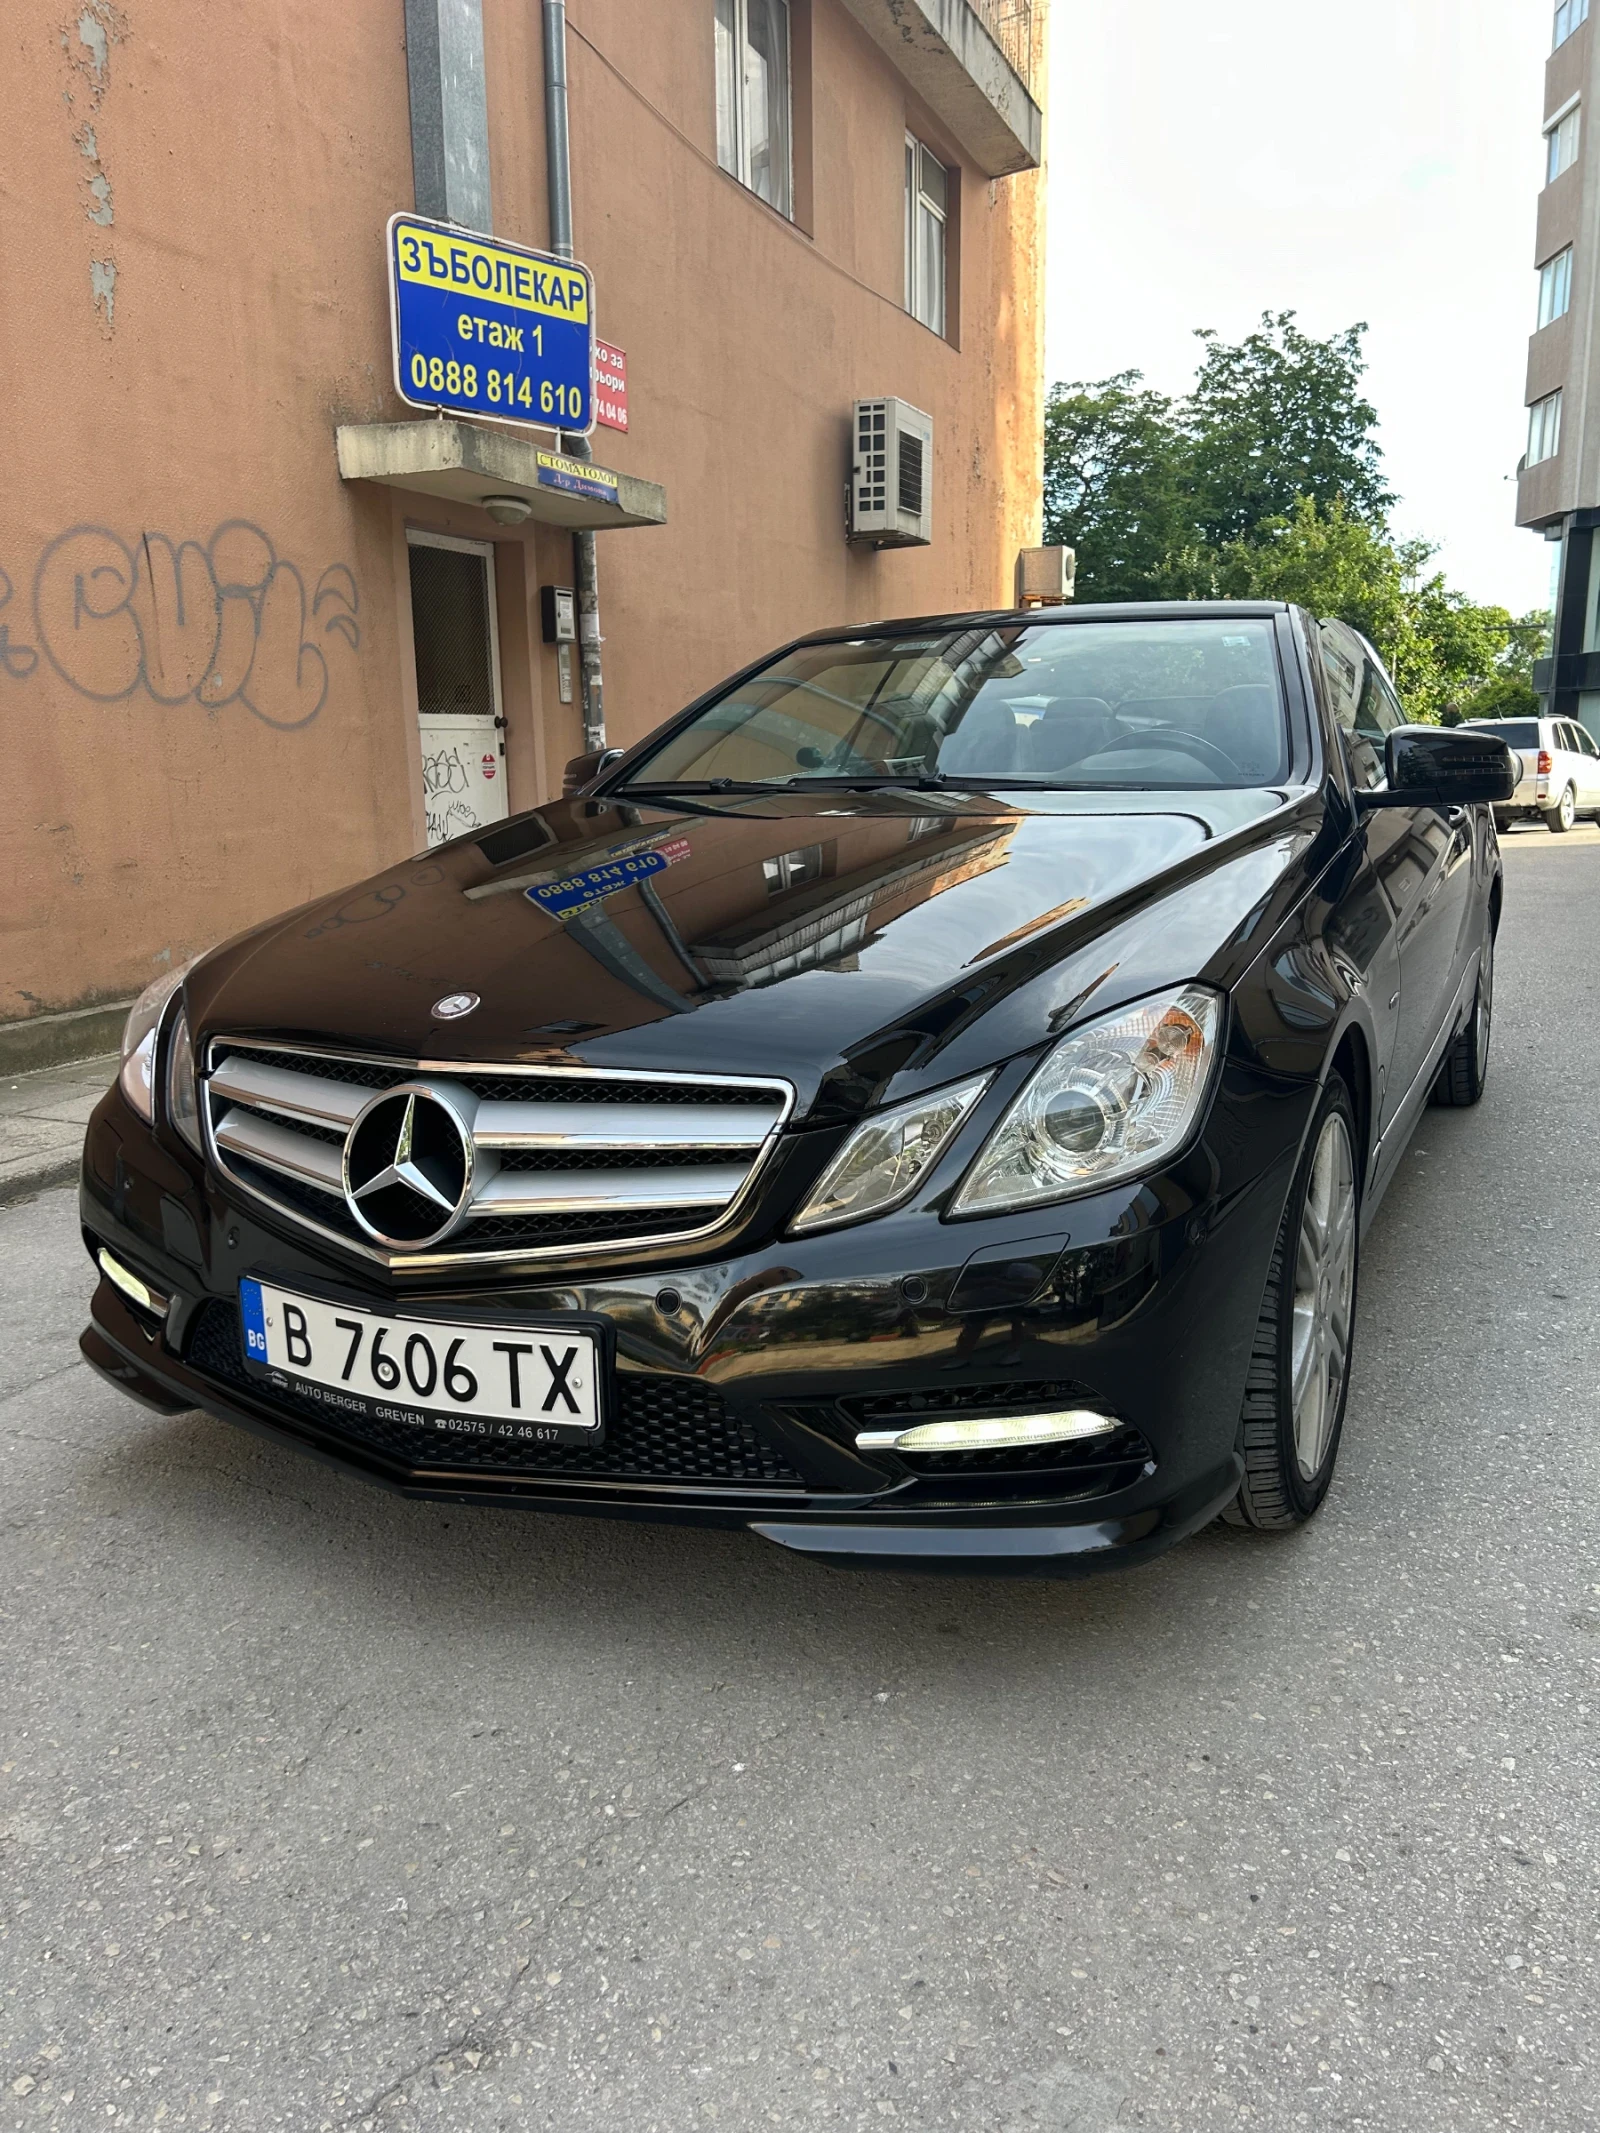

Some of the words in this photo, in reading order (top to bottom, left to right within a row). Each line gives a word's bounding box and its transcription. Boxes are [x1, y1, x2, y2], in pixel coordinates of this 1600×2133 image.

[402, 236, 584, 312] ЗЪБОЛЕКАР
[457, 313, 524, 352] етаж
[532, 325, 543, 357] 1
[610, 353, 624, 369] за
[411, 353, 478, 398] 0888
[487, 369, 532, 409] 814
[540, 380, 582, 419] 610
[606, 402, 617, 421] 04
[617, 406, 628, 425] 06
[540, 454, 617, 485] СТОМАТОЛОГ
[247, 1329, 265, 1351] BG
[283, 1302, 313, 1367] B
[335, 1317, 478, 1403] 7606
[493, 1341, 582, 1414] TX
[295, 1382, 321, 1400] AUTO
[323, 1392, 367, 1413] BERGER
[375, 1406, 425, 1426] GREVEN
[448, 1418, 486, 1434] 02575
[498, 1425, 514, 1437] 42
[517, 1426, 533, 1438] 46
[536, 1428, 559, 1441] 617
